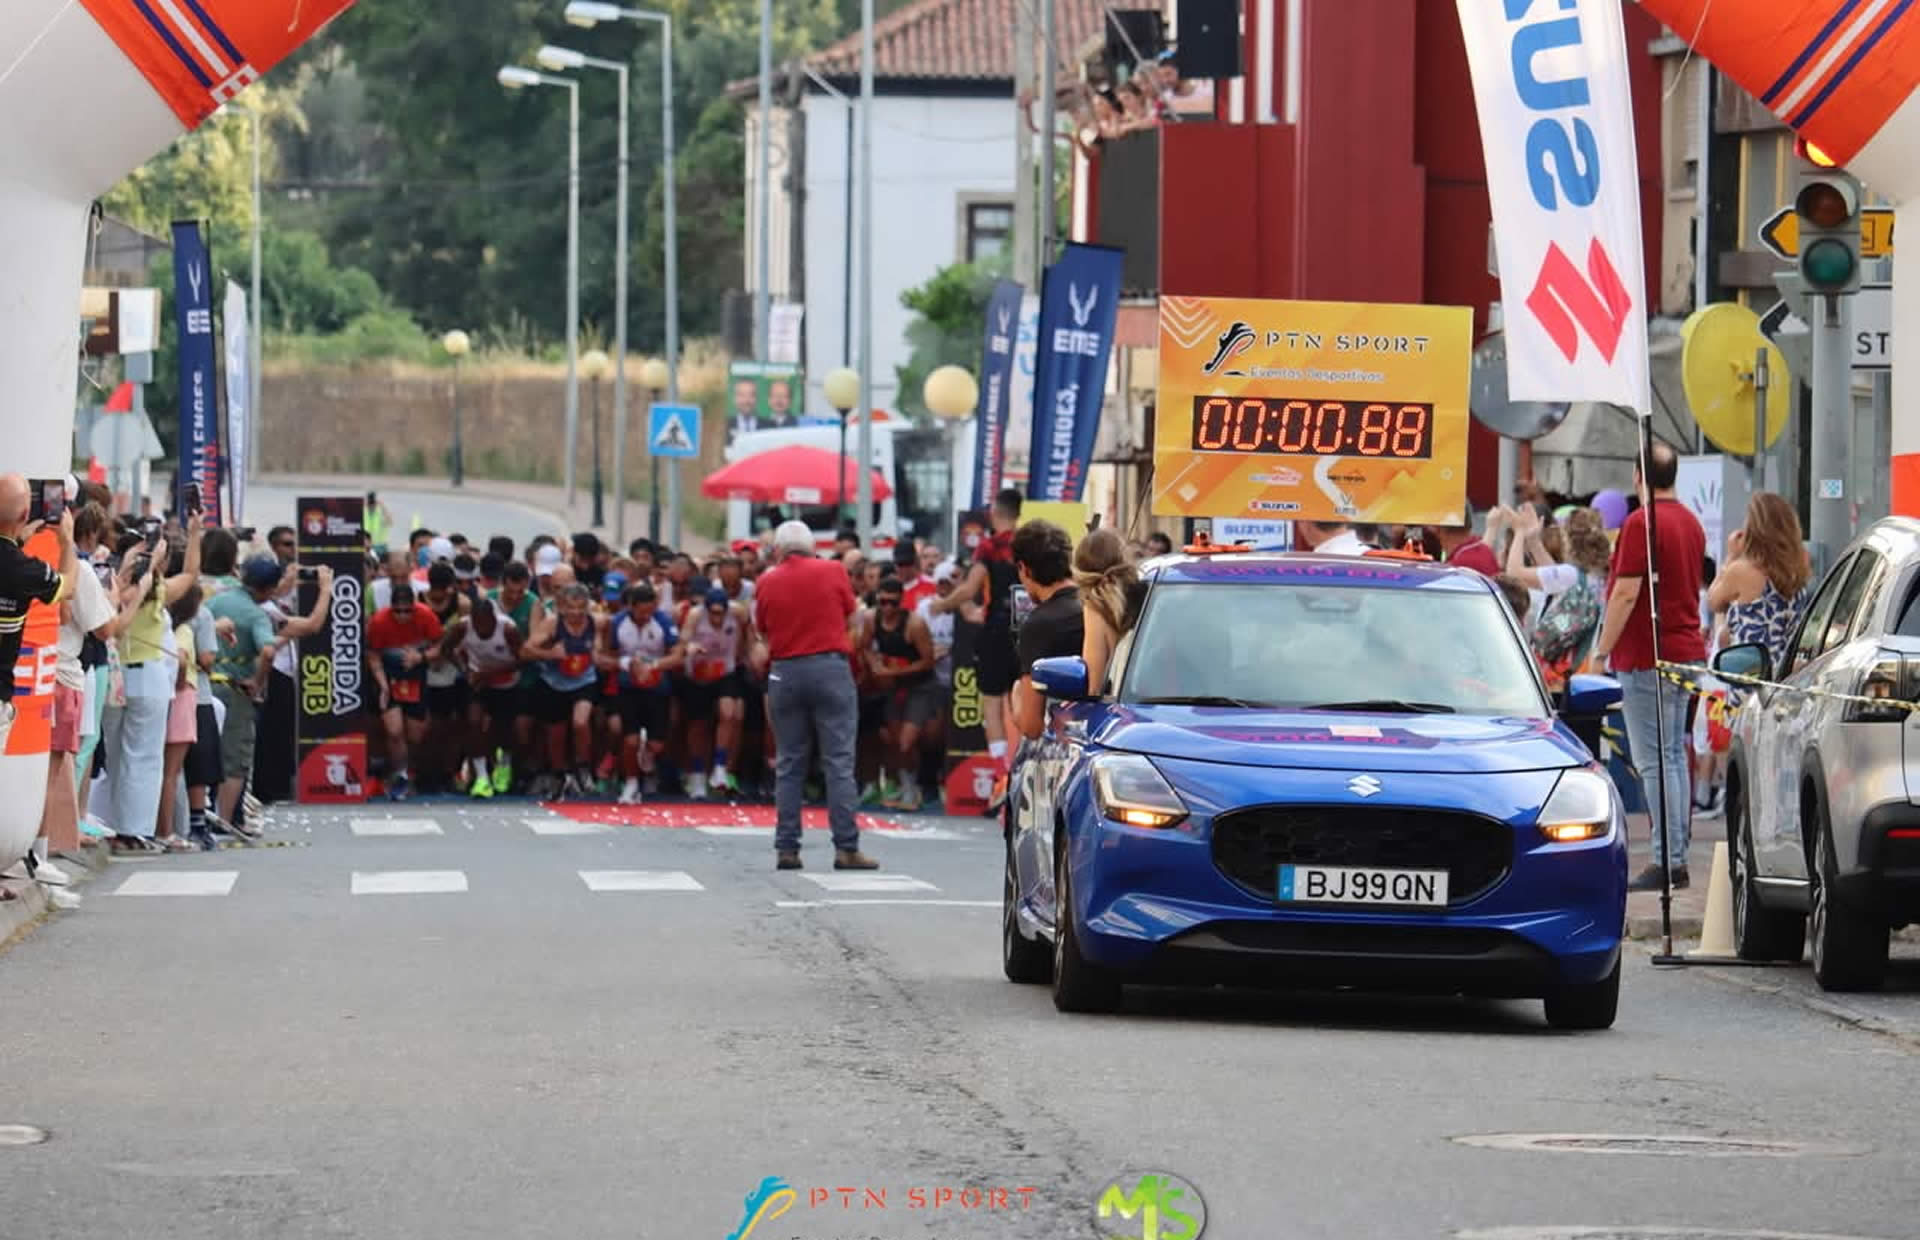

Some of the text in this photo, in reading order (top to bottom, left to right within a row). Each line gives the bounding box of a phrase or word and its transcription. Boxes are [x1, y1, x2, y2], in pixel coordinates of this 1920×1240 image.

[1503, 0, 1600, 211] SU
[1267, 332, 1429, 352] PTN SPORT
[1261, 503, 1299, 511] SUZUKI
[332, 576, 361, 715] CORRIDA
[303, 656, 332, 715] STB
[952, 668, 984, 728] STB
